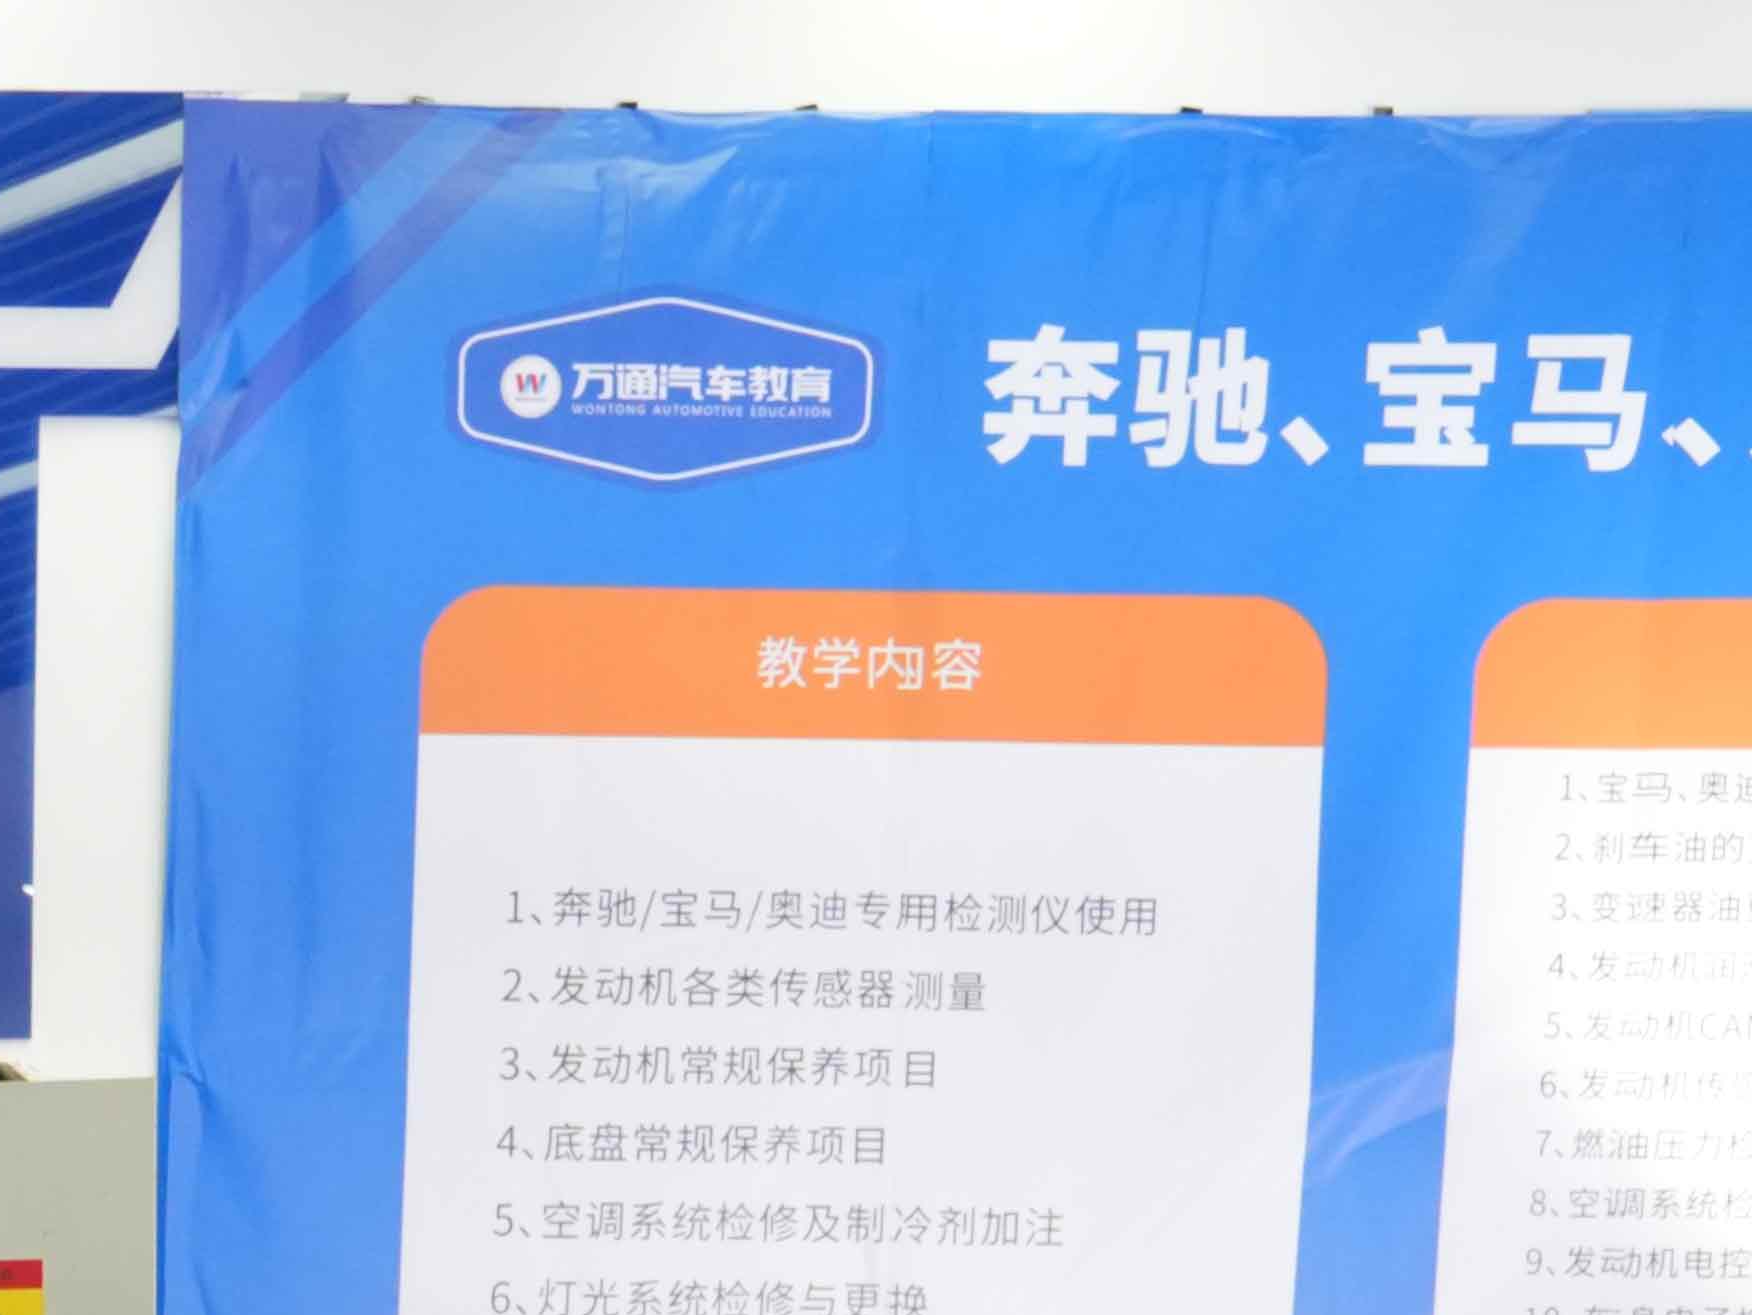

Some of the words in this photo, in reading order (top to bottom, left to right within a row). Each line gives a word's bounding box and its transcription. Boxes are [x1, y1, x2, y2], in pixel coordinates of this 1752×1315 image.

[572, 363, 832, 403] 万通汽车教育
[653, 404, 743, 418] AUTOMOTIVE
[750, 405, 831, 419] EDUCATION
[756, 636, 983, 692] 教学内容
[507, 886, 1157, 936] 1、奔驰/宝马/奥迪专用检测仪使用
[1552, 892, 1752, 922] 3、变速器油
[501, 965, 986, 1011] 2、发动机各类传感器测量
[499, 1044, 935, 1088] 3、发动机常规保养项目
[496, 1122, 885, 1165] 4、底盘常规保养项目
[493, 1200, 1064, 1246] 5、空调系统检修及制冷剂加注
